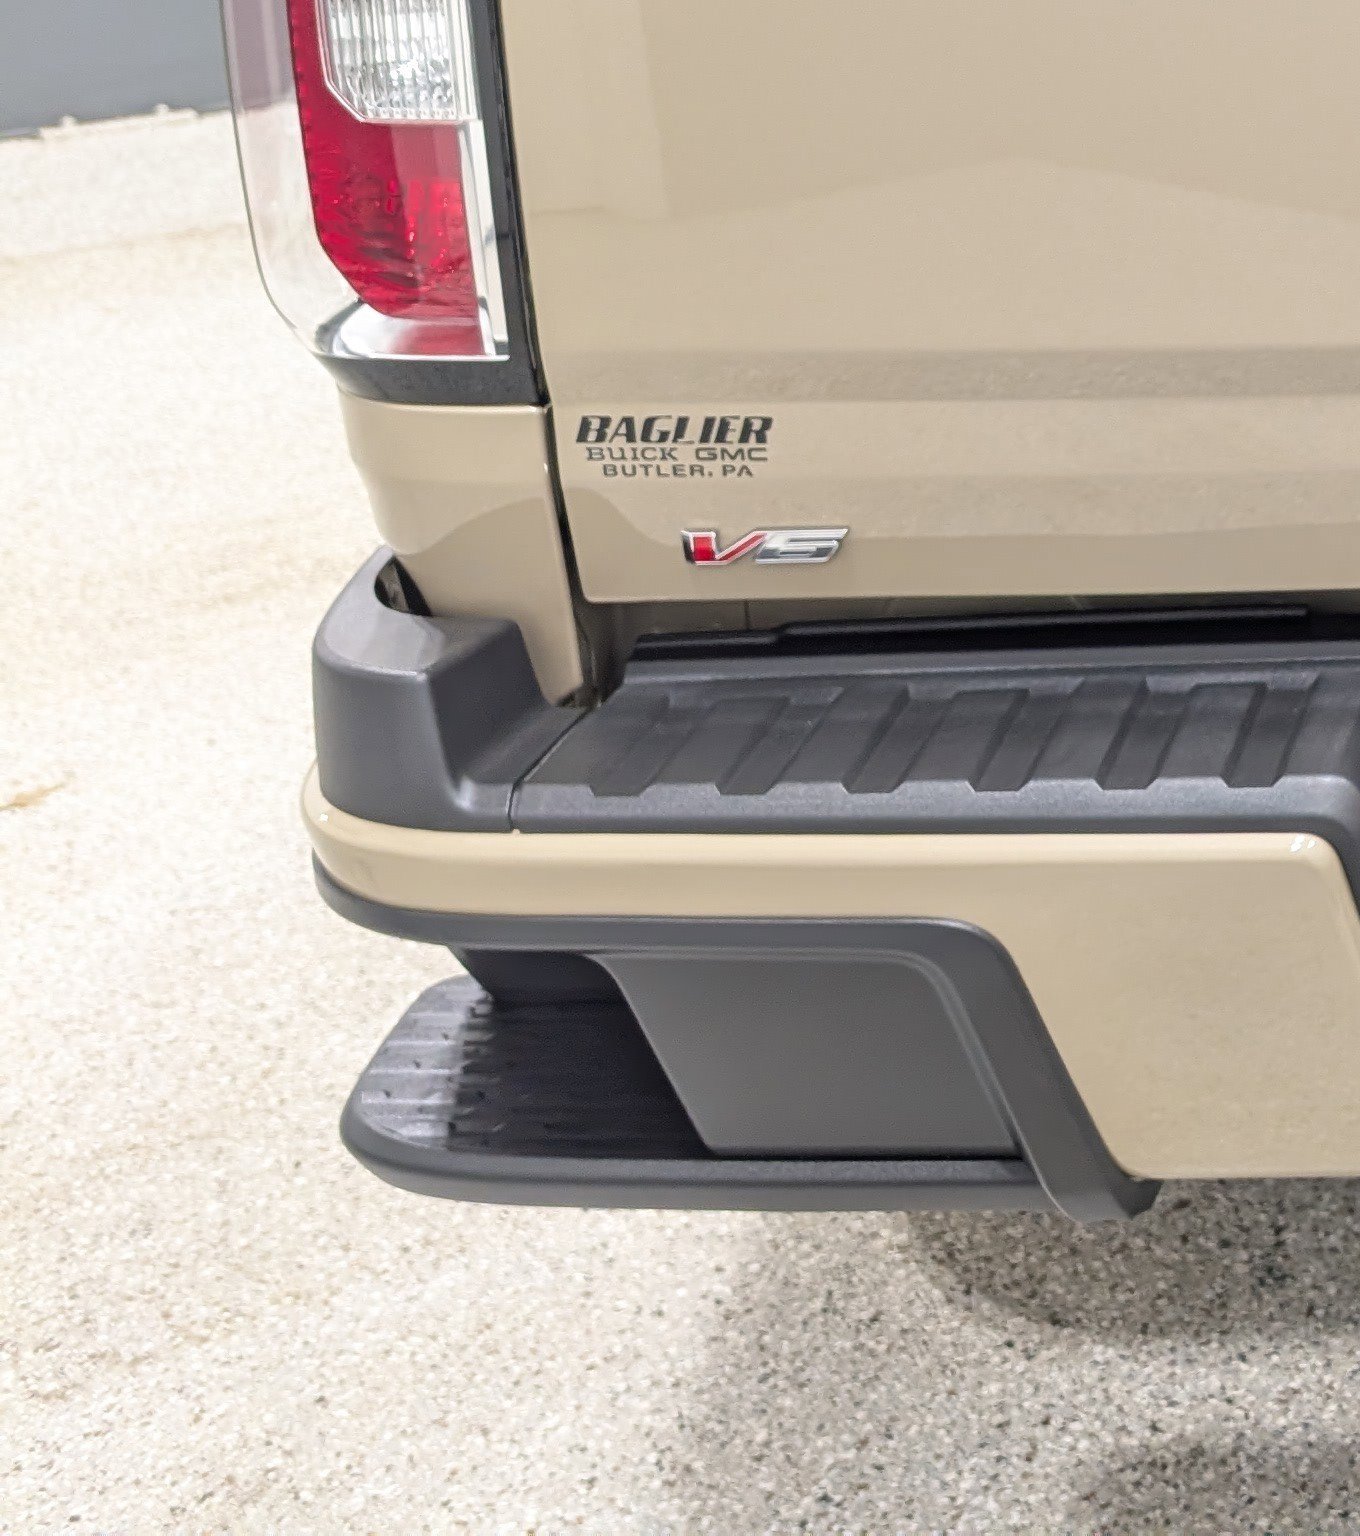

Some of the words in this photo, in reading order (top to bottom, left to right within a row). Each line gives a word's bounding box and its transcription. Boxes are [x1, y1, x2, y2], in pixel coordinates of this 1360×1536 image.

[576, 414, 773, 445] BAGLIER
[586, 447, 678, 462] BUICK
[695, 447, 769, 462] GMC
[721, 464, 754, 478] PA
[681, 527, 848, 566] V6
